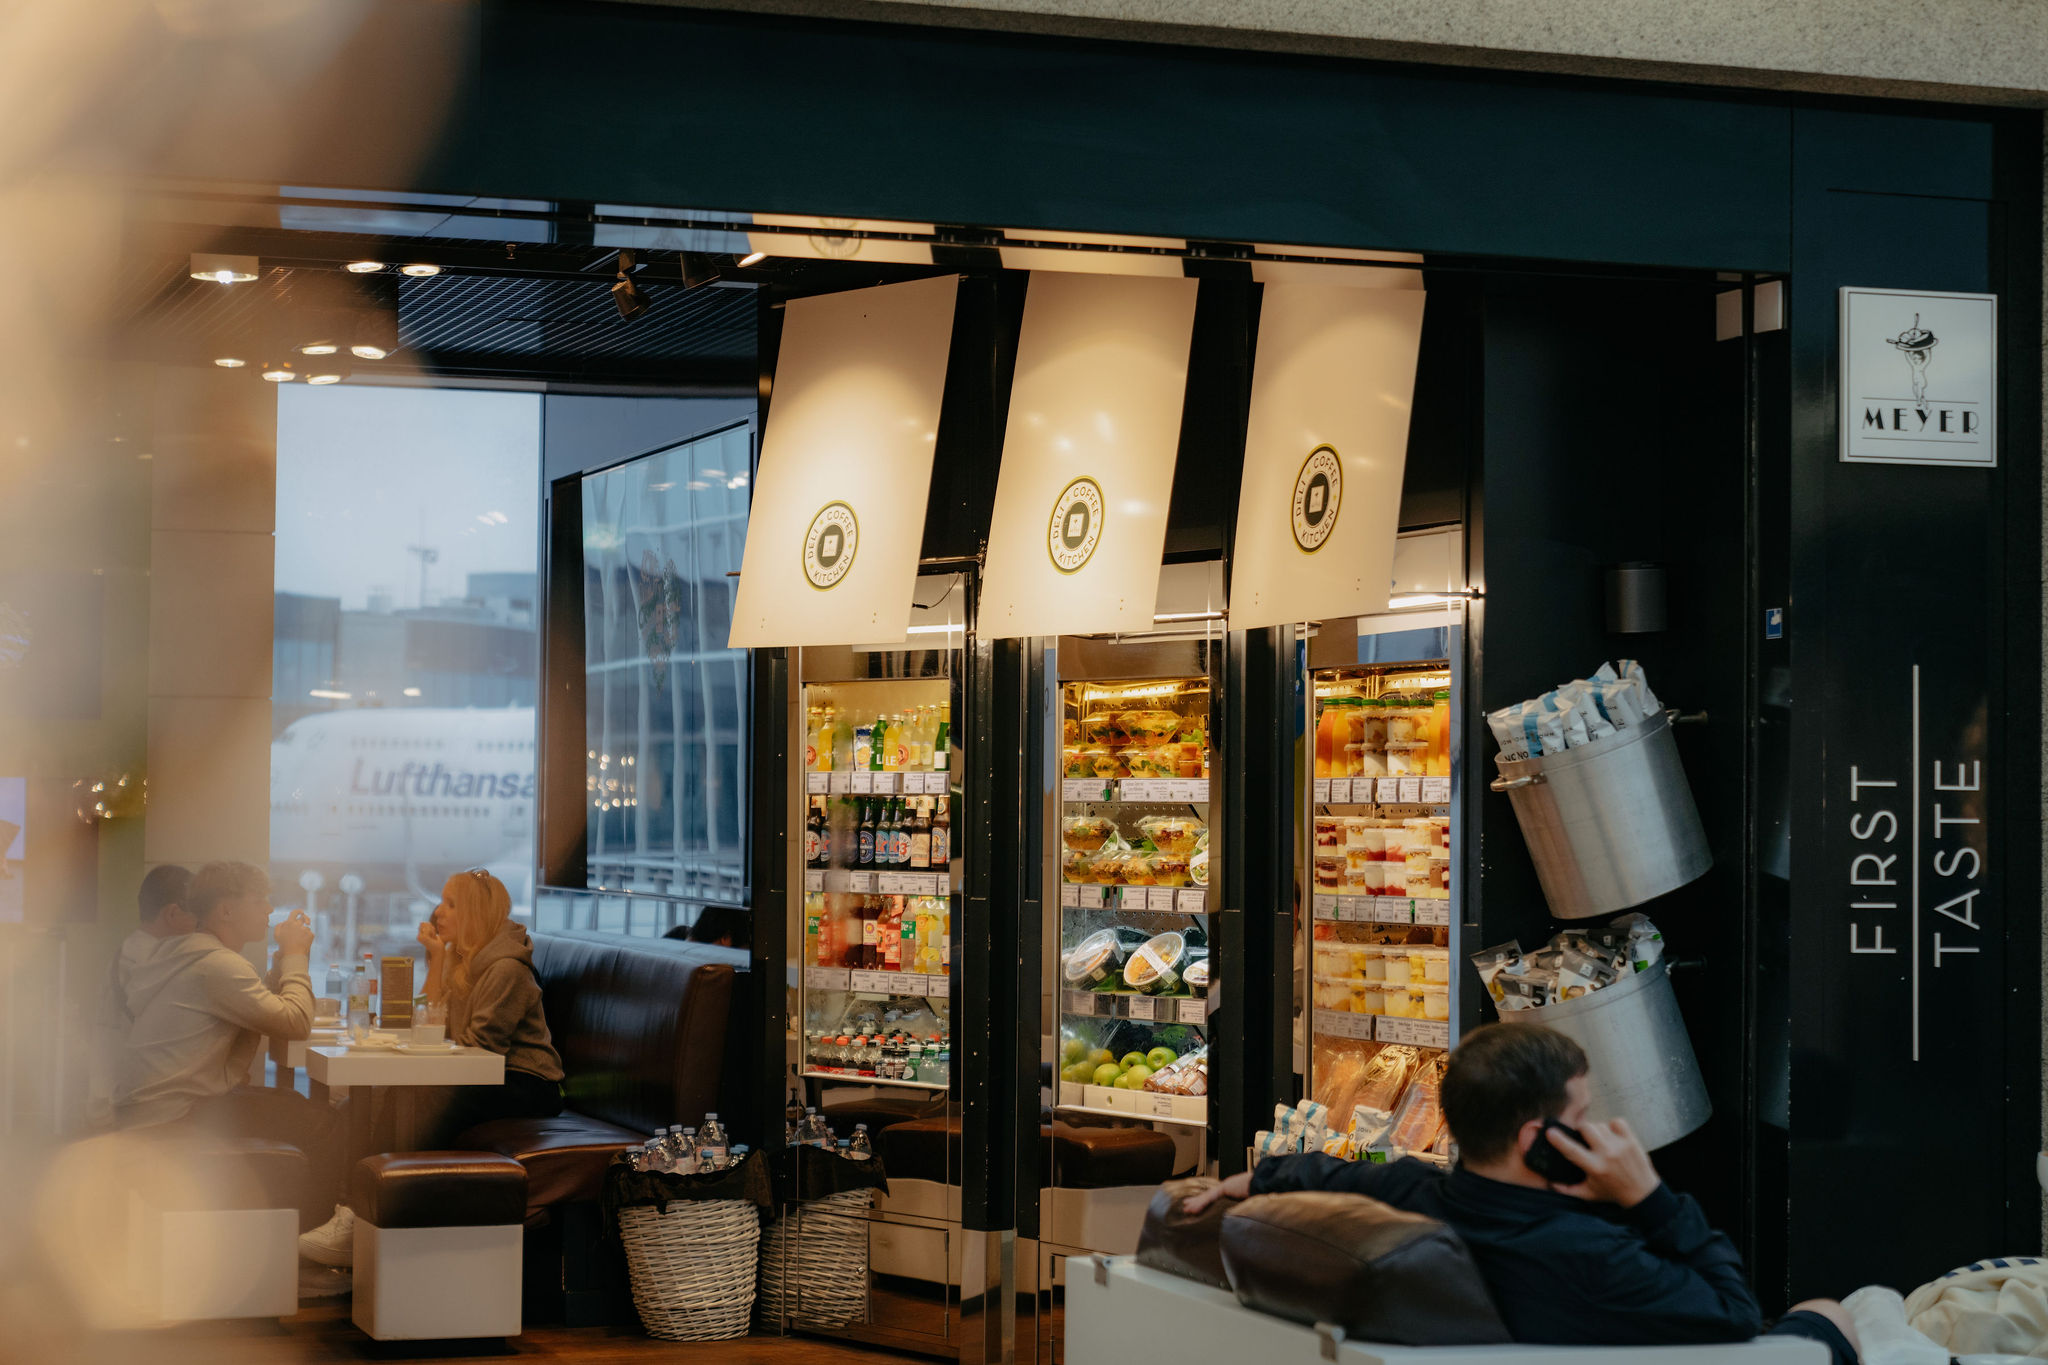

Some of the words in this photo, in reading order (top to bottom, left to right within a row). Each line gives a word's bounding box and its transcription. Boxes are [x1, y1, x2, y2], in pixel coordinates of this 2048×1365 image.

[1862, 408, 1980, 435] MEYER
[1313, 455, 1338, 488] COFFEE
[1073, 486, 1099, 516] COFFEE
[1296, 481, 1306, 517] DELI
[826, 510, 854, 537] COFFEE
[1052, 506, 1065, 540] DELI
[1301, 508, 1334, 544] KITCHEN
[807, 528, 819, 559] DELI
[1058, 535, 1095, 566] KITCHEN
[813, 555, 849, 583] KITCHEN
[1850, 765, 1897, 954] FIRST
[1933, 760, 1981, 967] TASTE
